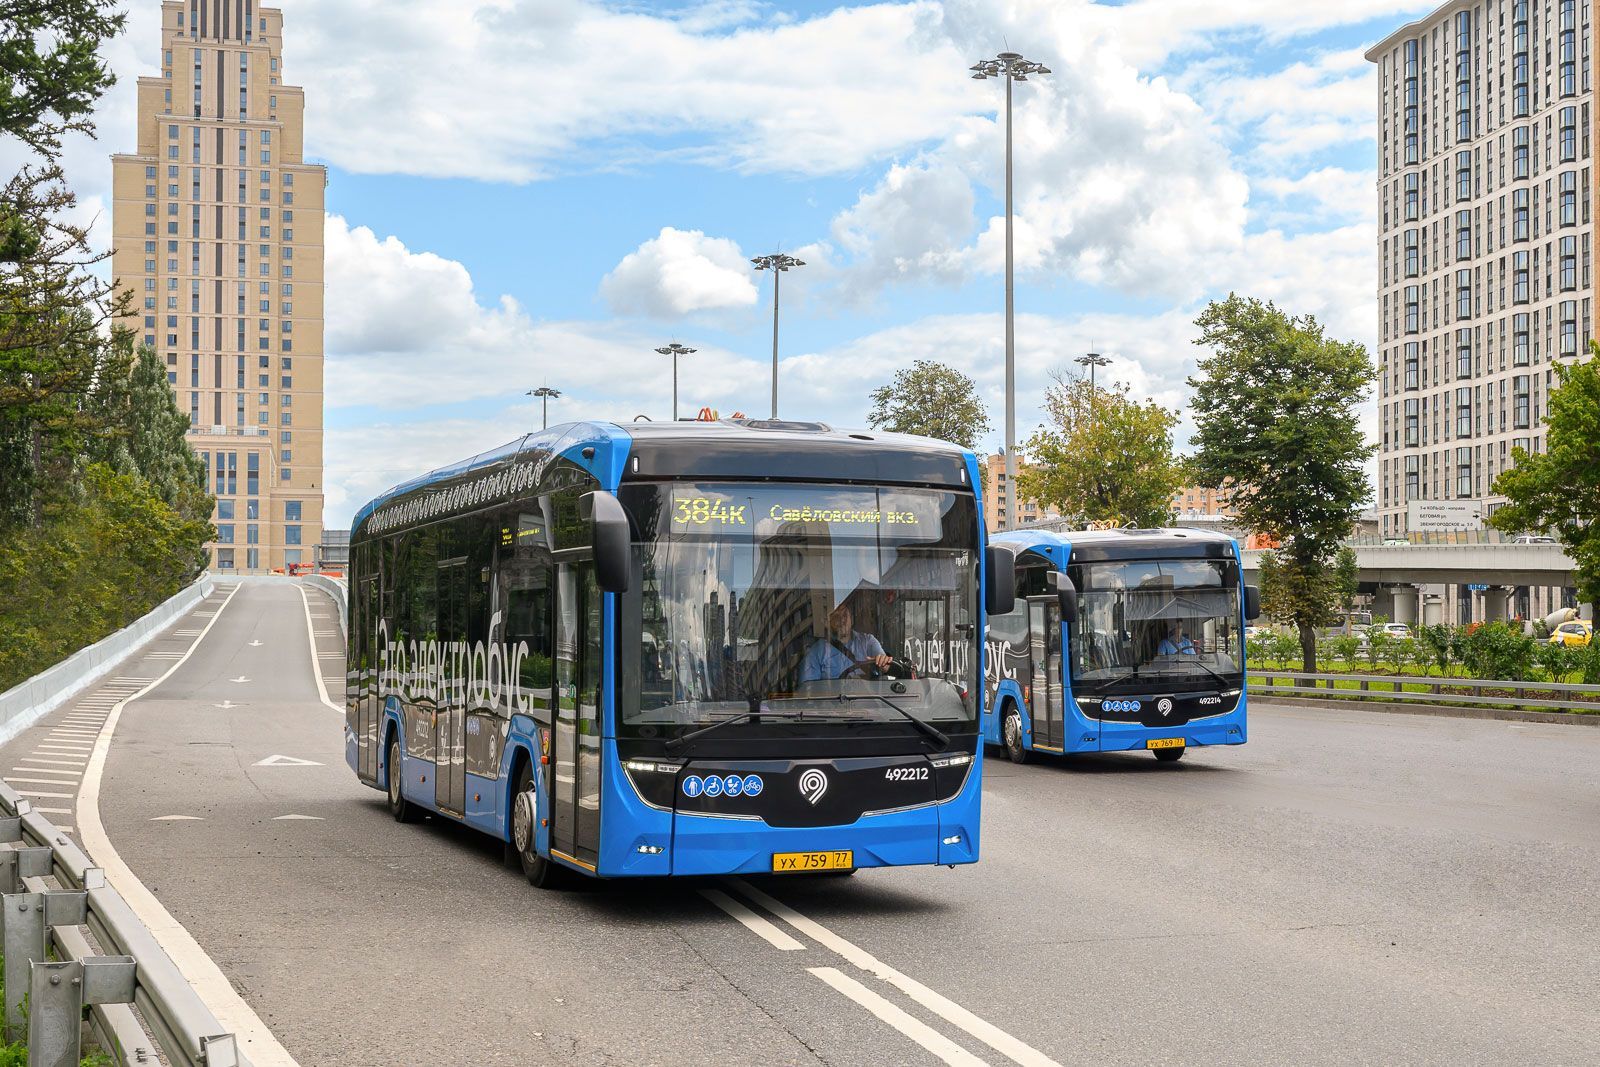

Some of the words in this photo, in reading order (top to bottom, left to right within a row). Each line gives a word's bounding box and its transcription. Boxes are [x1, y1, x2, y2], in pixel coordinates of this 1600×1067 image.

[769, 504, 881, 524] Савёловский
[376, 617, 406, 696] Это
[885, 767, 929, 781] 492212
[802, 854, 827, 868] 759
[834, 852, 848, 863] 77
